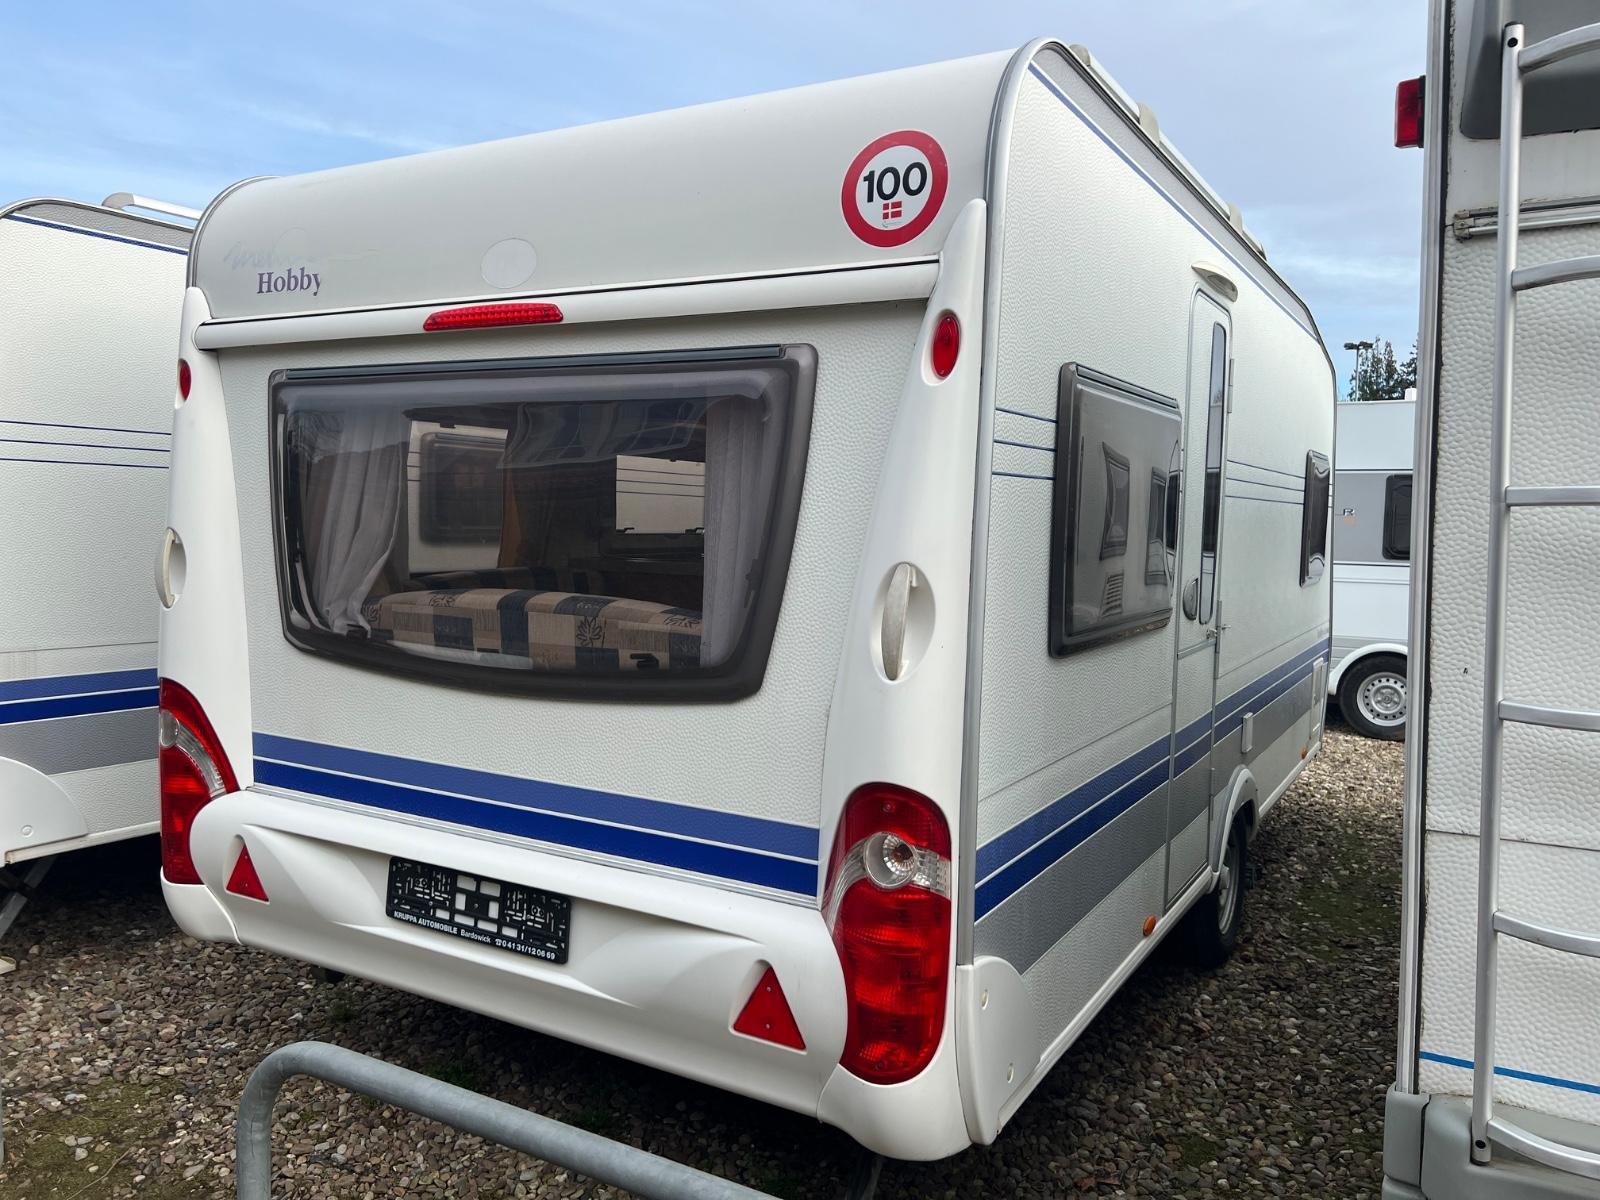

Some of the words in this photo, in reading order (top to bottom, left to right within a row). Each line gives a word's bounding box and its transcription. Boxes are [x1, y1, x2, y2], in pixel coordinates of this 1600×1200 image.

[863, 161, 928, 203] 100
[256, 266, 321, 297] Hobby
[393, 910, 417, 923] KRUPPA
[418, 917, 458, 934] AUTOMOBILE
[460, 929, 491, 943] Bardowick
